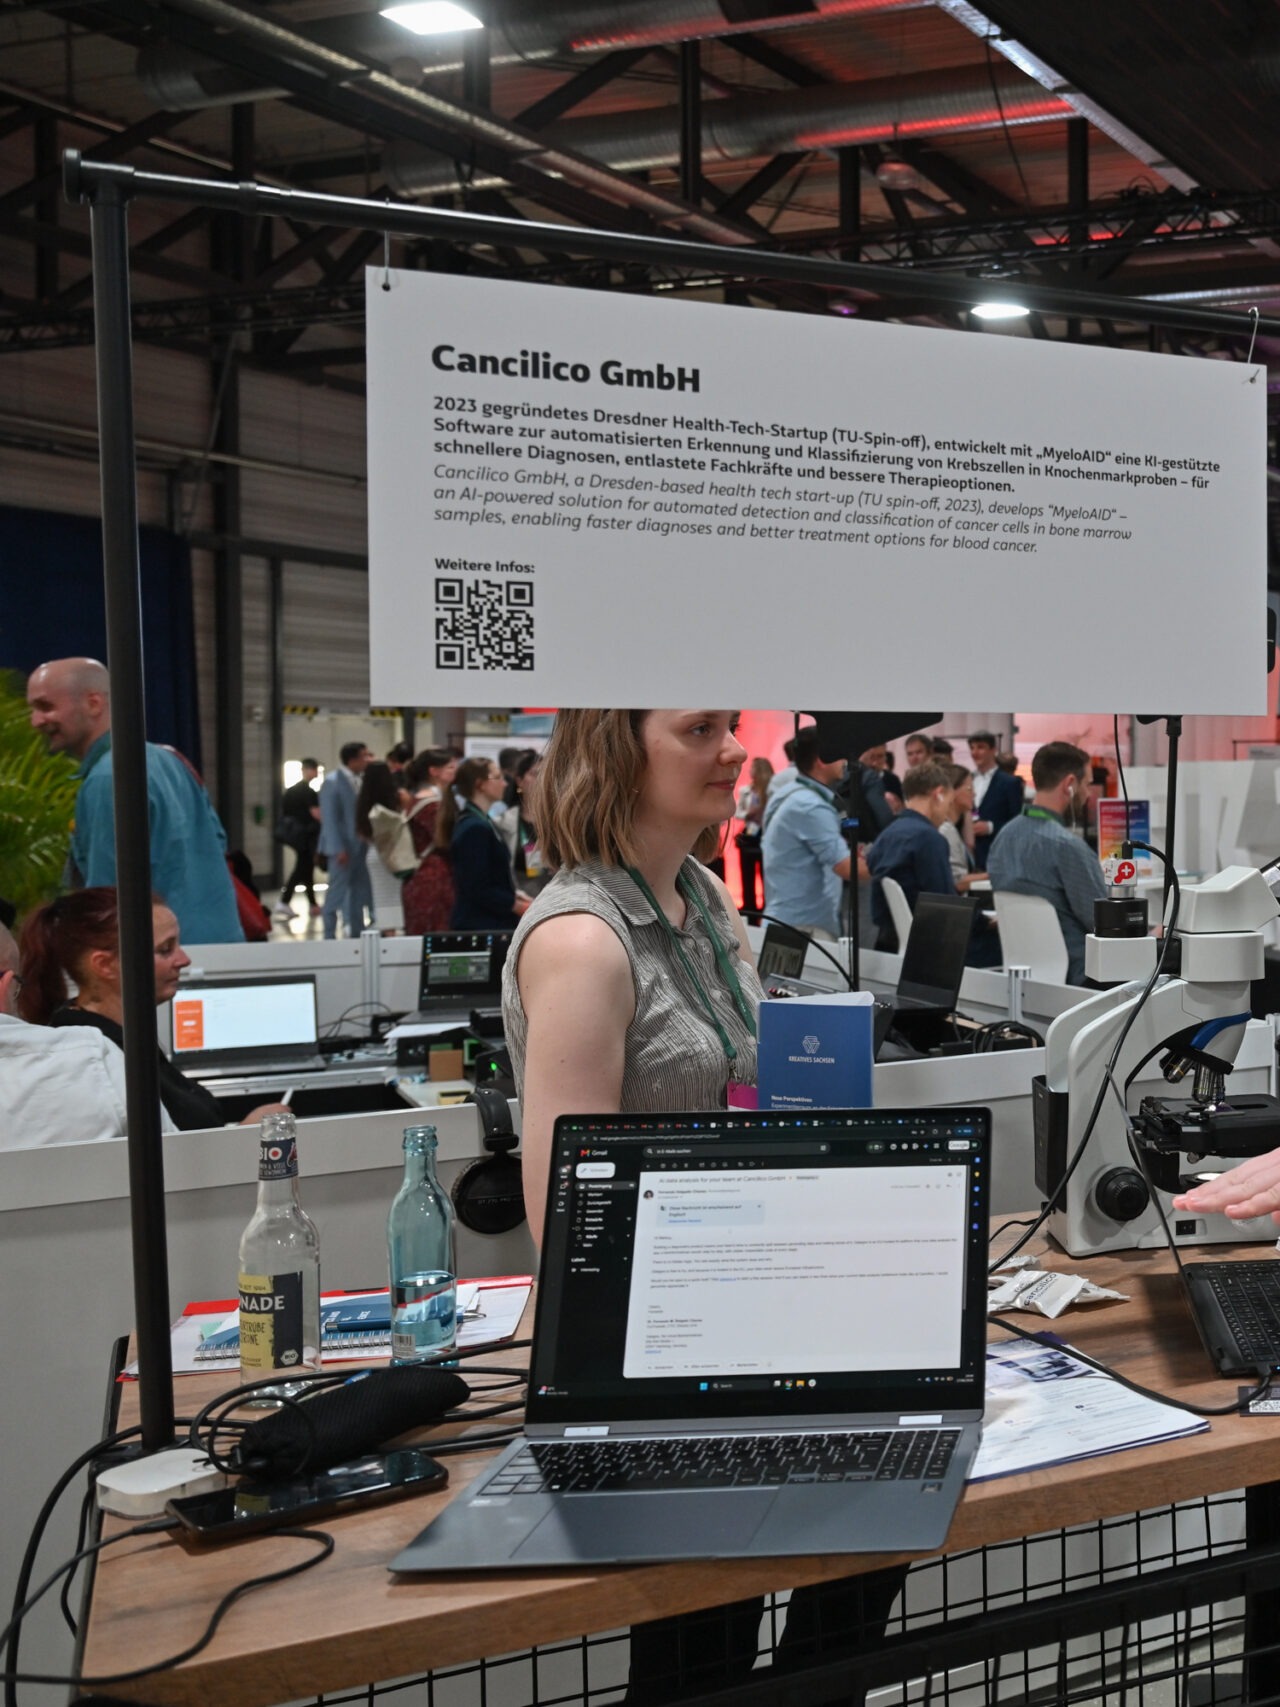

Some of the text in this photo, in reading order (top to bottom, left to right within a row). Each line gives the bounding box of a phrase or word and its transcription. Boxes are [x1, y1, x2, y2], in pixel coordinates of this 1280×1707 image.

[431, 344, 700, 393] Cancilico GmbH
[434, 396, 477, 413] 2023
[482, 402, 588, 421] gegründetes
[594, 409, 668, 427] Dresdner
[673, 416, 828, 444] Health-Tech-Startup
[832, 427, 930, 452] (TU-Spin-off),
[934, 440, 1006, 455] entwickelt
[1011, 444, 1032, 457] mit
[1115, 452, 1141, 466] eine
[1145, 455, 1220, 472] KI-gestützte
[434, 417, 513, 436] Software
[519, 427, 546, 438] zur
[550, 429, 682, 449] automatisierten
[688, 437, 770, 459] Erkennung
[775, 445, 803, 458] und
[808, 446, 913, 470] Klassifizierung
[917, 458, 942, 468] von
[947, 457, 1024, 474] Krebszellen
[1029, 463, 1040, 476] in
[1045, 465, 1177, 487] Knochenmarkproben
[1191, 476, 1210, 488] für
[434, 440, 1015, 492] schnellere Diagnosen, entlastete Fachkräfte und bessere Therapieoptionen.
[434, 464, 509, 482] Cancilico
[514, 469, 569, 488] GmbH,
[575, 477, 584, 487] a
[590, 474, 704, 494] Dresden-based
[709, 482, 756, 497] health
[761, 487, 791, 500] tech
[796, 490, 854, 507] start-up
[858, 491, 883, 508] (TU
[886, 496, 940, 513] spin-off,
[945, 498, 984, 515] 2023),
[989, 501, 1043, 519] develops
[434, 486, 1132, 540] an AI-powered solution for automated detection and classification of cancer cells in bone marrow
[434, 509, 1037, 552] samples, enabling faster diagnoses and better treatment options for blood cancer.
[435, 558, 535, 573] Weitere Infos:
[813, 1056, 835, 1064] SACHSEN
